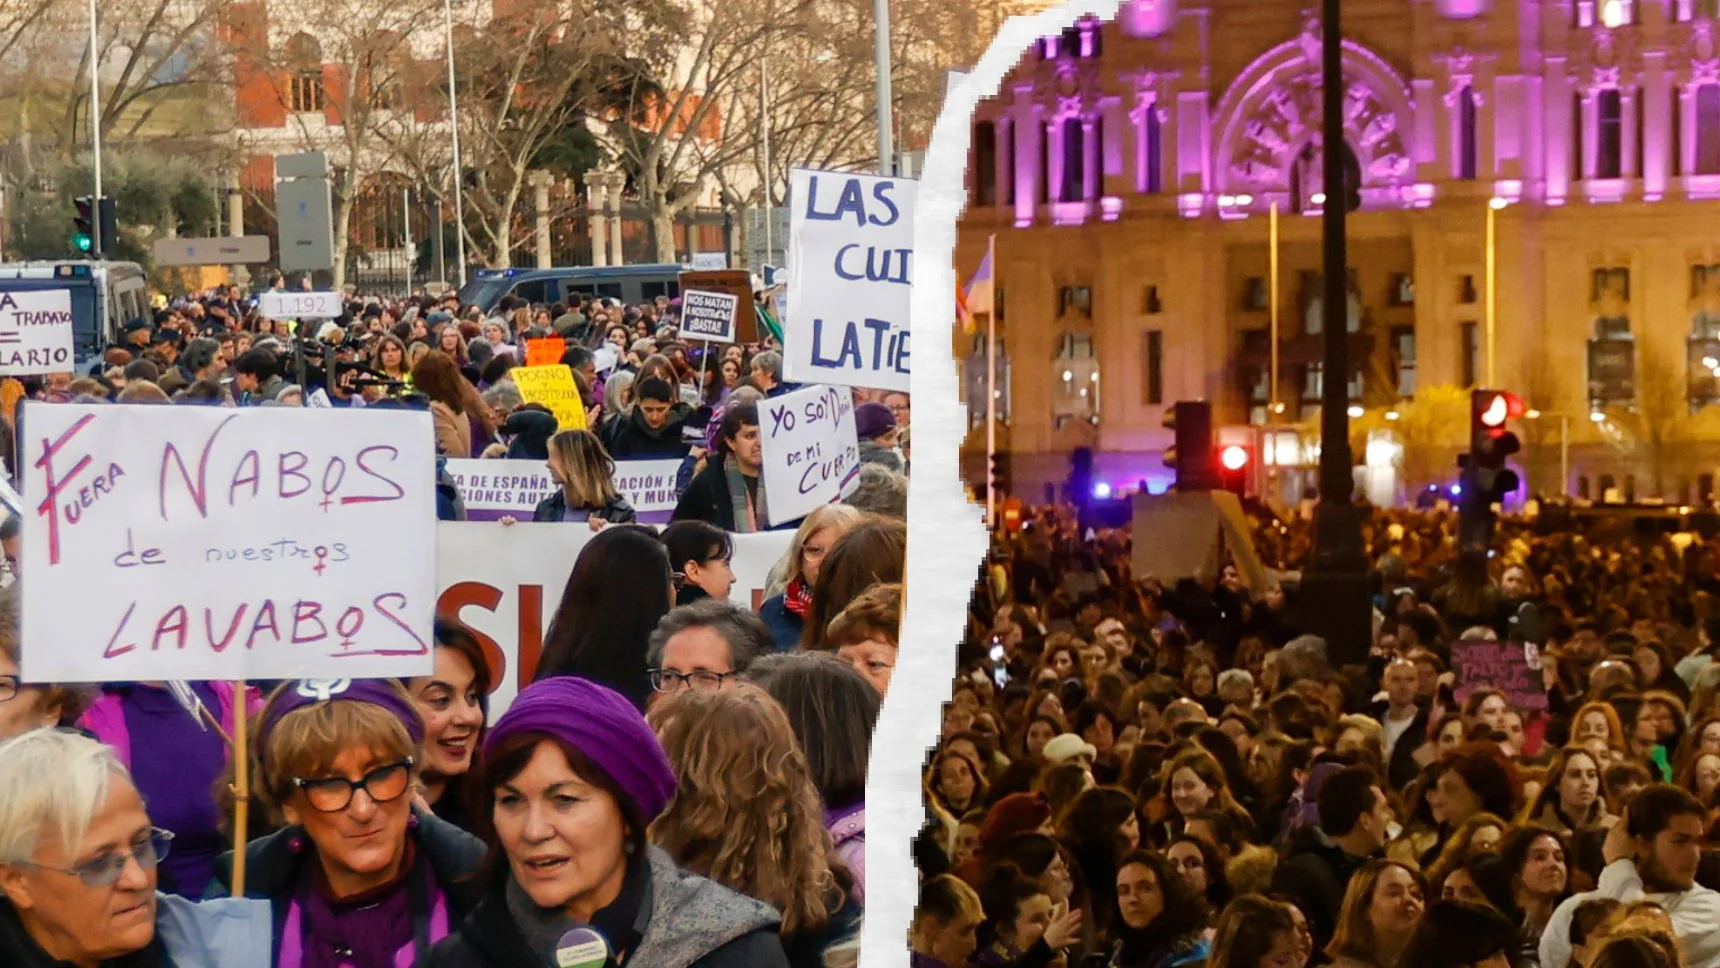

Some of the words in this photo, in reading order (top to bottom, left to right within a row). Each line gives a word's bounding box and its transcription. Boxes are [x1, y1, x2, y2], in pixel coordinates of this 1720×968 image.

[806, 176, 900, 227] LAS
[834, 244, 913, 285] CUI
[275, 296, 327, 314] 1.192
[687, 295, 704, 306] NOS
[704, 297, 732, 310] MATAN
[770, 405, 796, 438] YO
[805, 394, 829, 424] SOY
[159, 414, 405, 522] NABOS
[787, 451, 802, 466] DE
[799, 446, 856, 494] CUERPO
[471, 475, 488, 487] DE
[493, 475, 548, 490] ESPAÑA
[632, 492, 639, 505] Y
[644, 490, 676, 505] MUN
[114, 528, 167, 567] de
[205, 537, 350, 576] nuestros
[103, 593, 429, 658] LAVABOS
